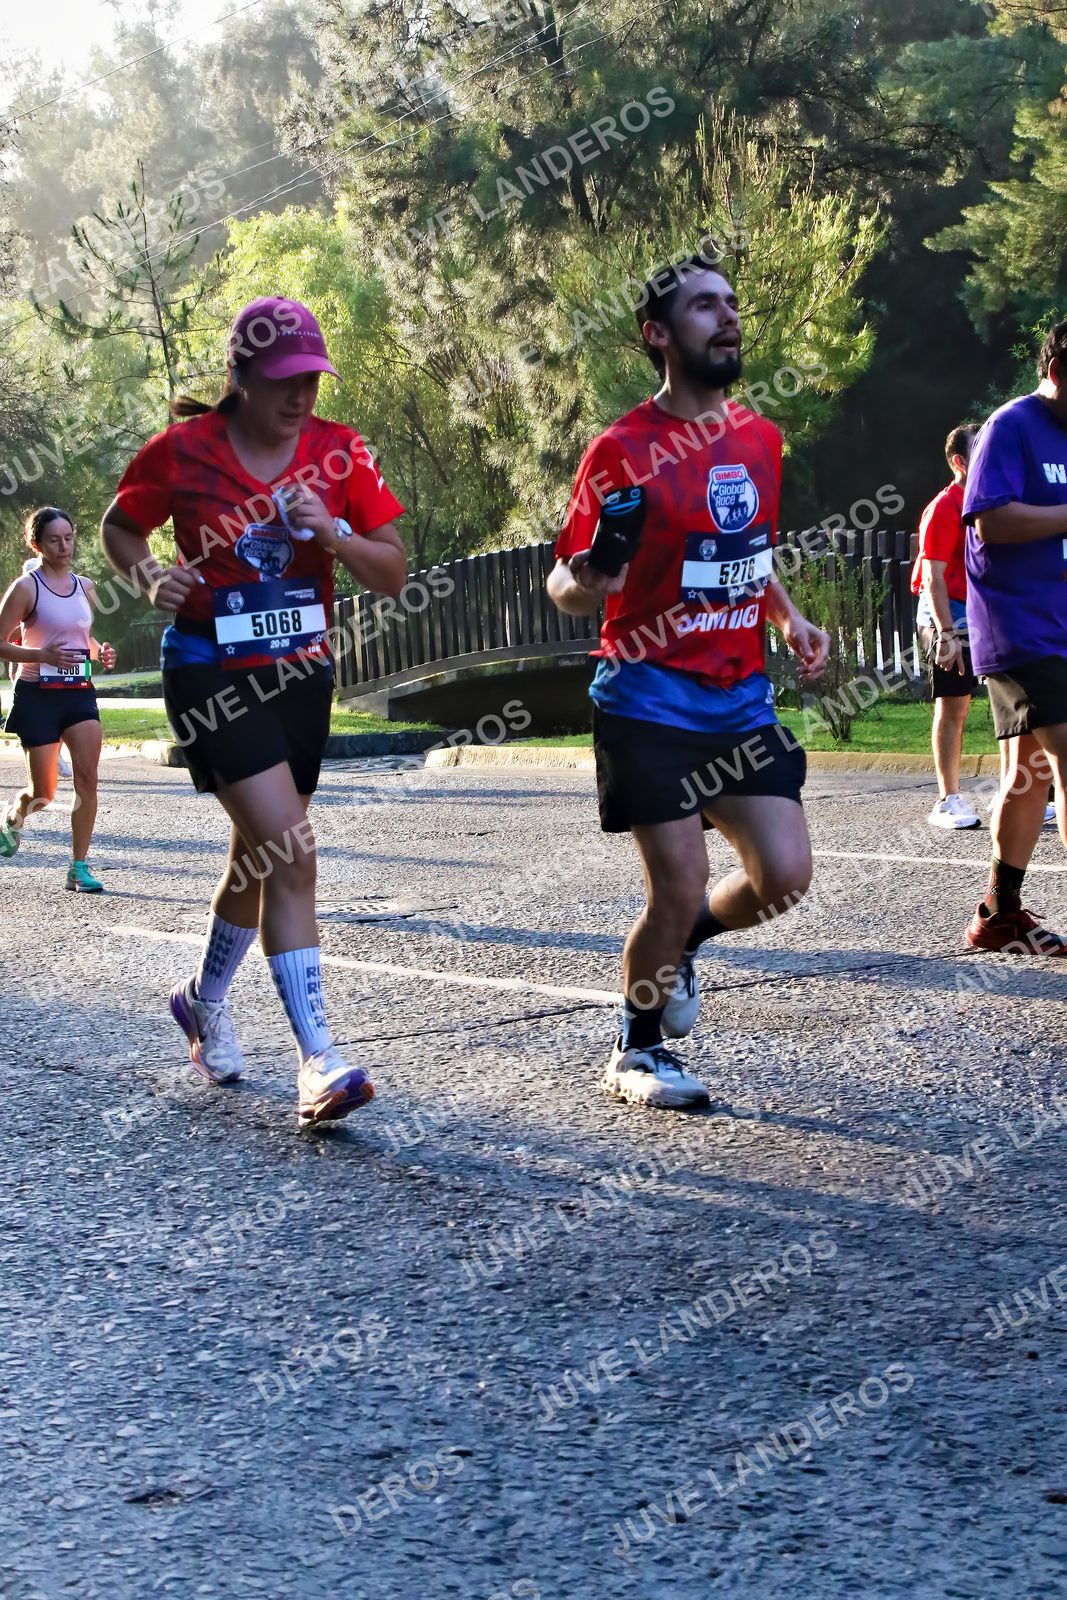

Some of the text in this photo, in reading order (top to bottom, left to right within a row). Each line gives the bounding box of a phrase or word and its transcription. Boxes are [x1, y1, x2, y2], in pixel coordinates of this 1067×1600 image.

[715, 471, 743, 480] BIMBO
[718, 482, 745, 495] Global
[715, 495, 736, 507] Race
[251, 609, 302, 637] 5068
